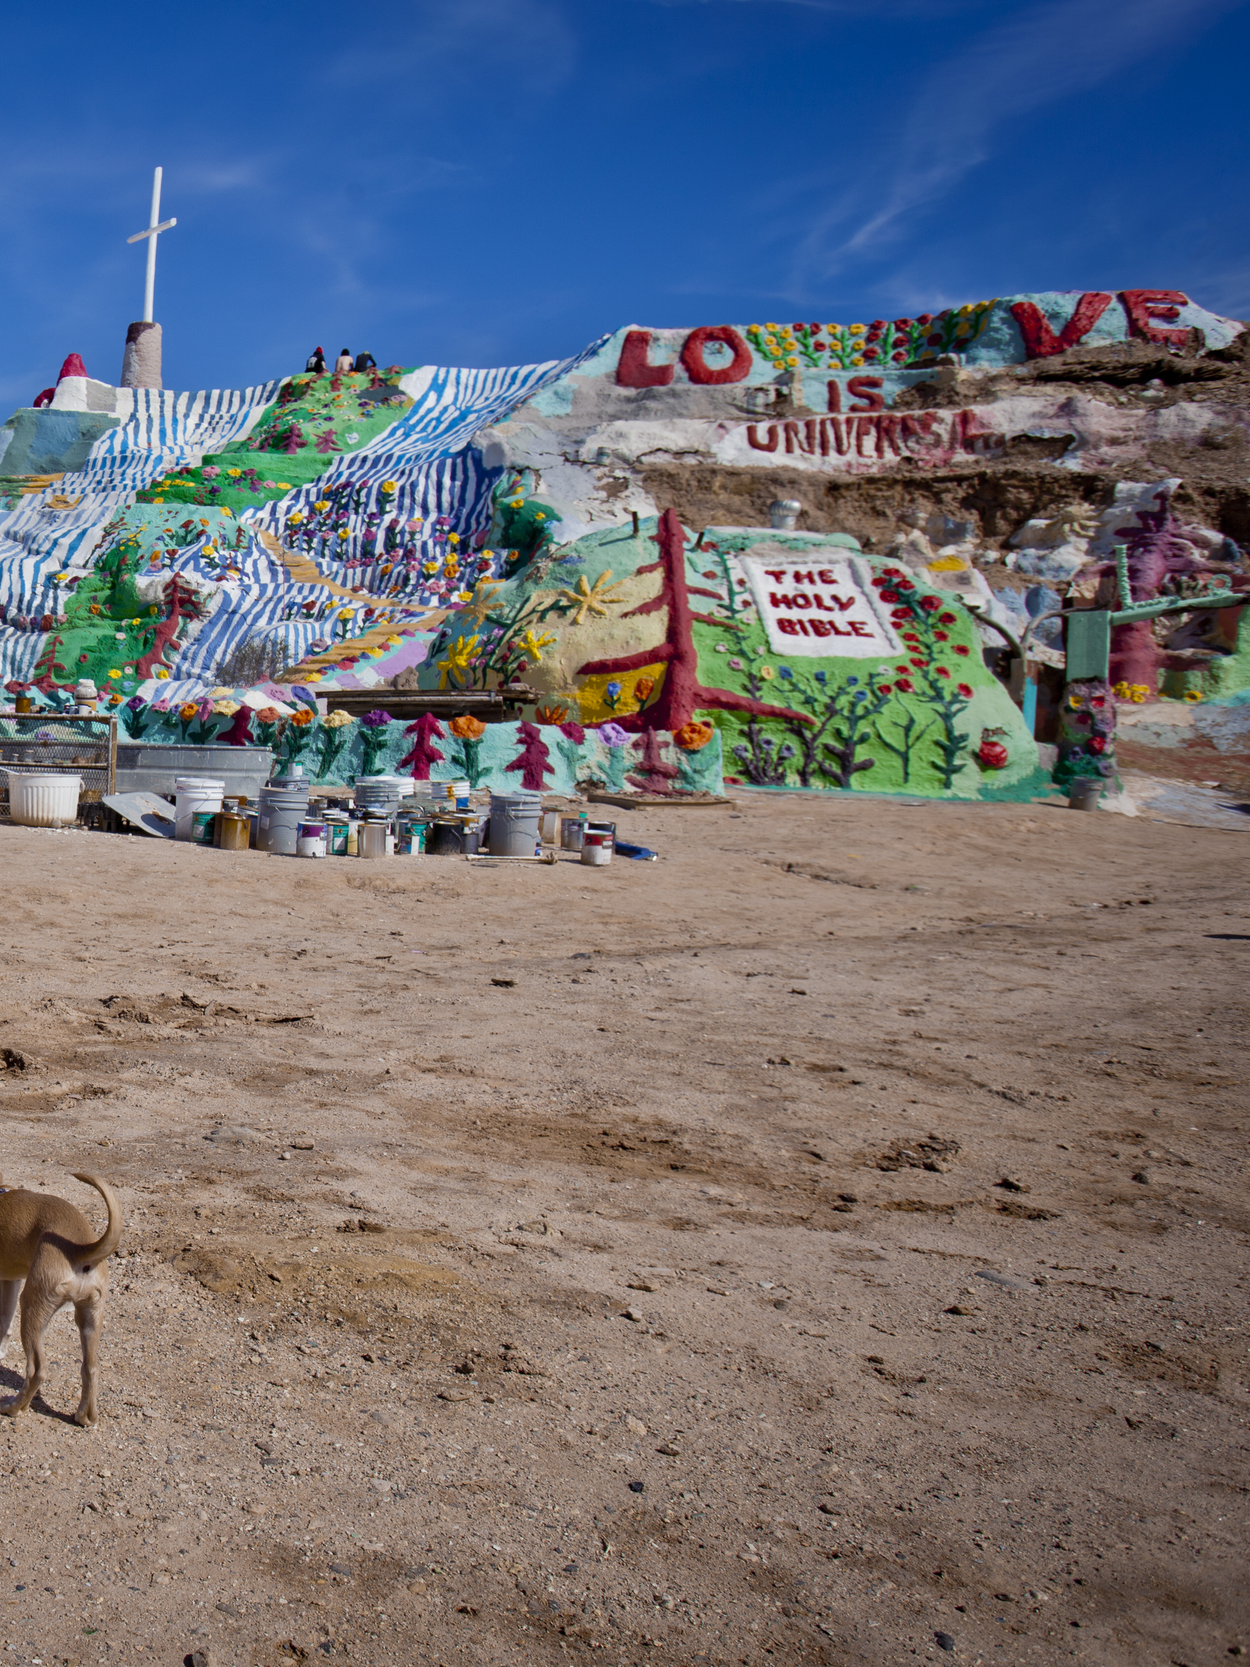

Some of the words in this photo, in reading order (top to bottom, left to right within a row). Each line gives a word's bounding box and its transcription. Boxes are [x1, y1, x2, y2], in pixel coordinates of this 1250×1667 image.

[826, 375, 885, 414] IS
[764, 569, 839, 586] THE
[769, 592, 855, 612] HOLY
[776, 617, 876, 639] BIBLE
